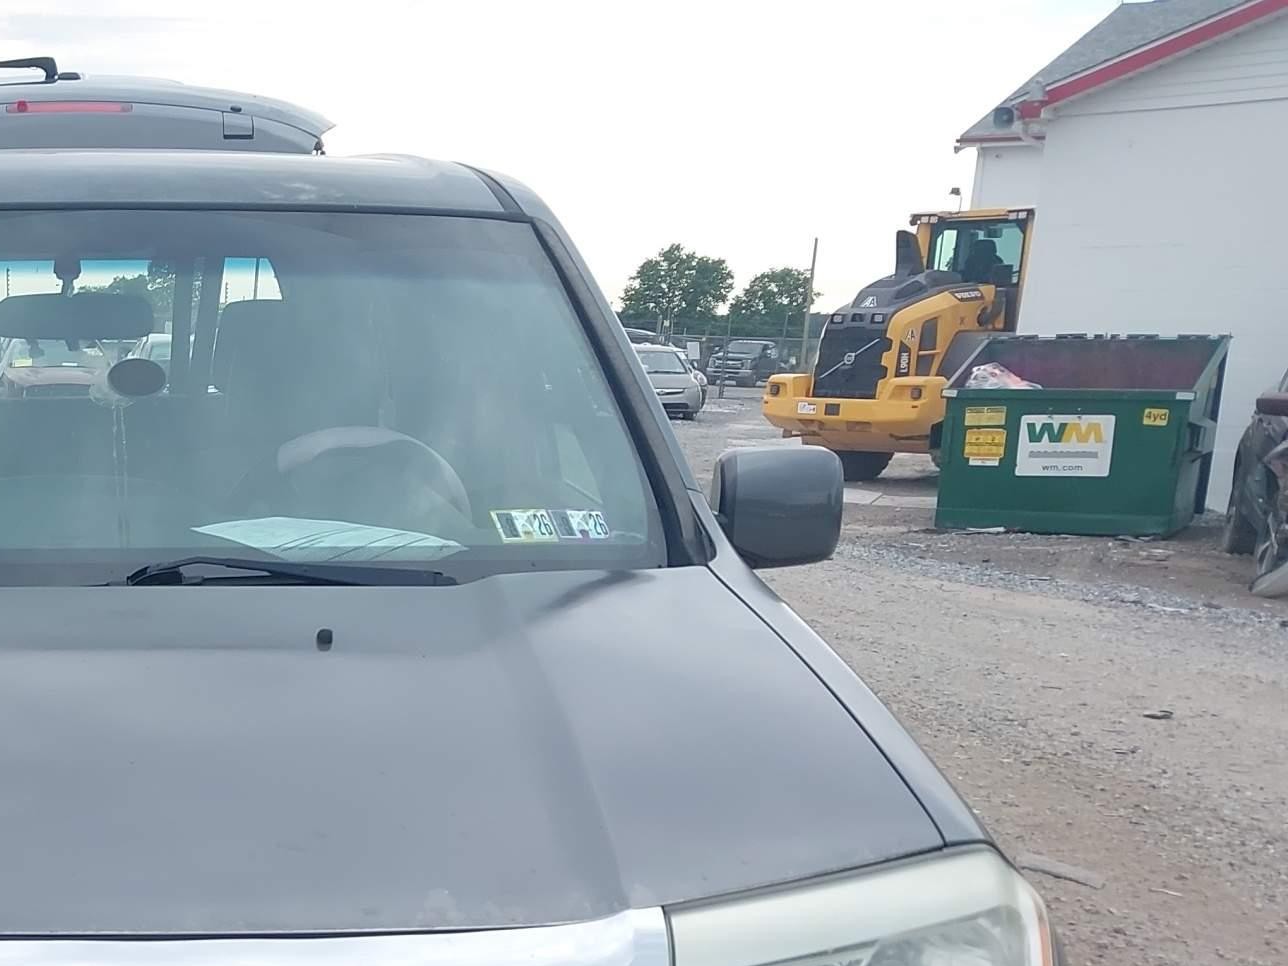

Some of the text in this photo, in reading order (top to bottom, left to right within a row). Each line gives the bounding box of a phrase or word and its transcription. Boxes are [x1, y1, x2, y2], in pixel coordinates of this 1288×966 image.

[1144, 411, 1167, 423] 4yd
[1026, 422, 1104, 444] WM
[1041, 464, 1084, 472] wm.com
[532, 513, 554, 537] 26
[588, 513, 609, 536] 26
